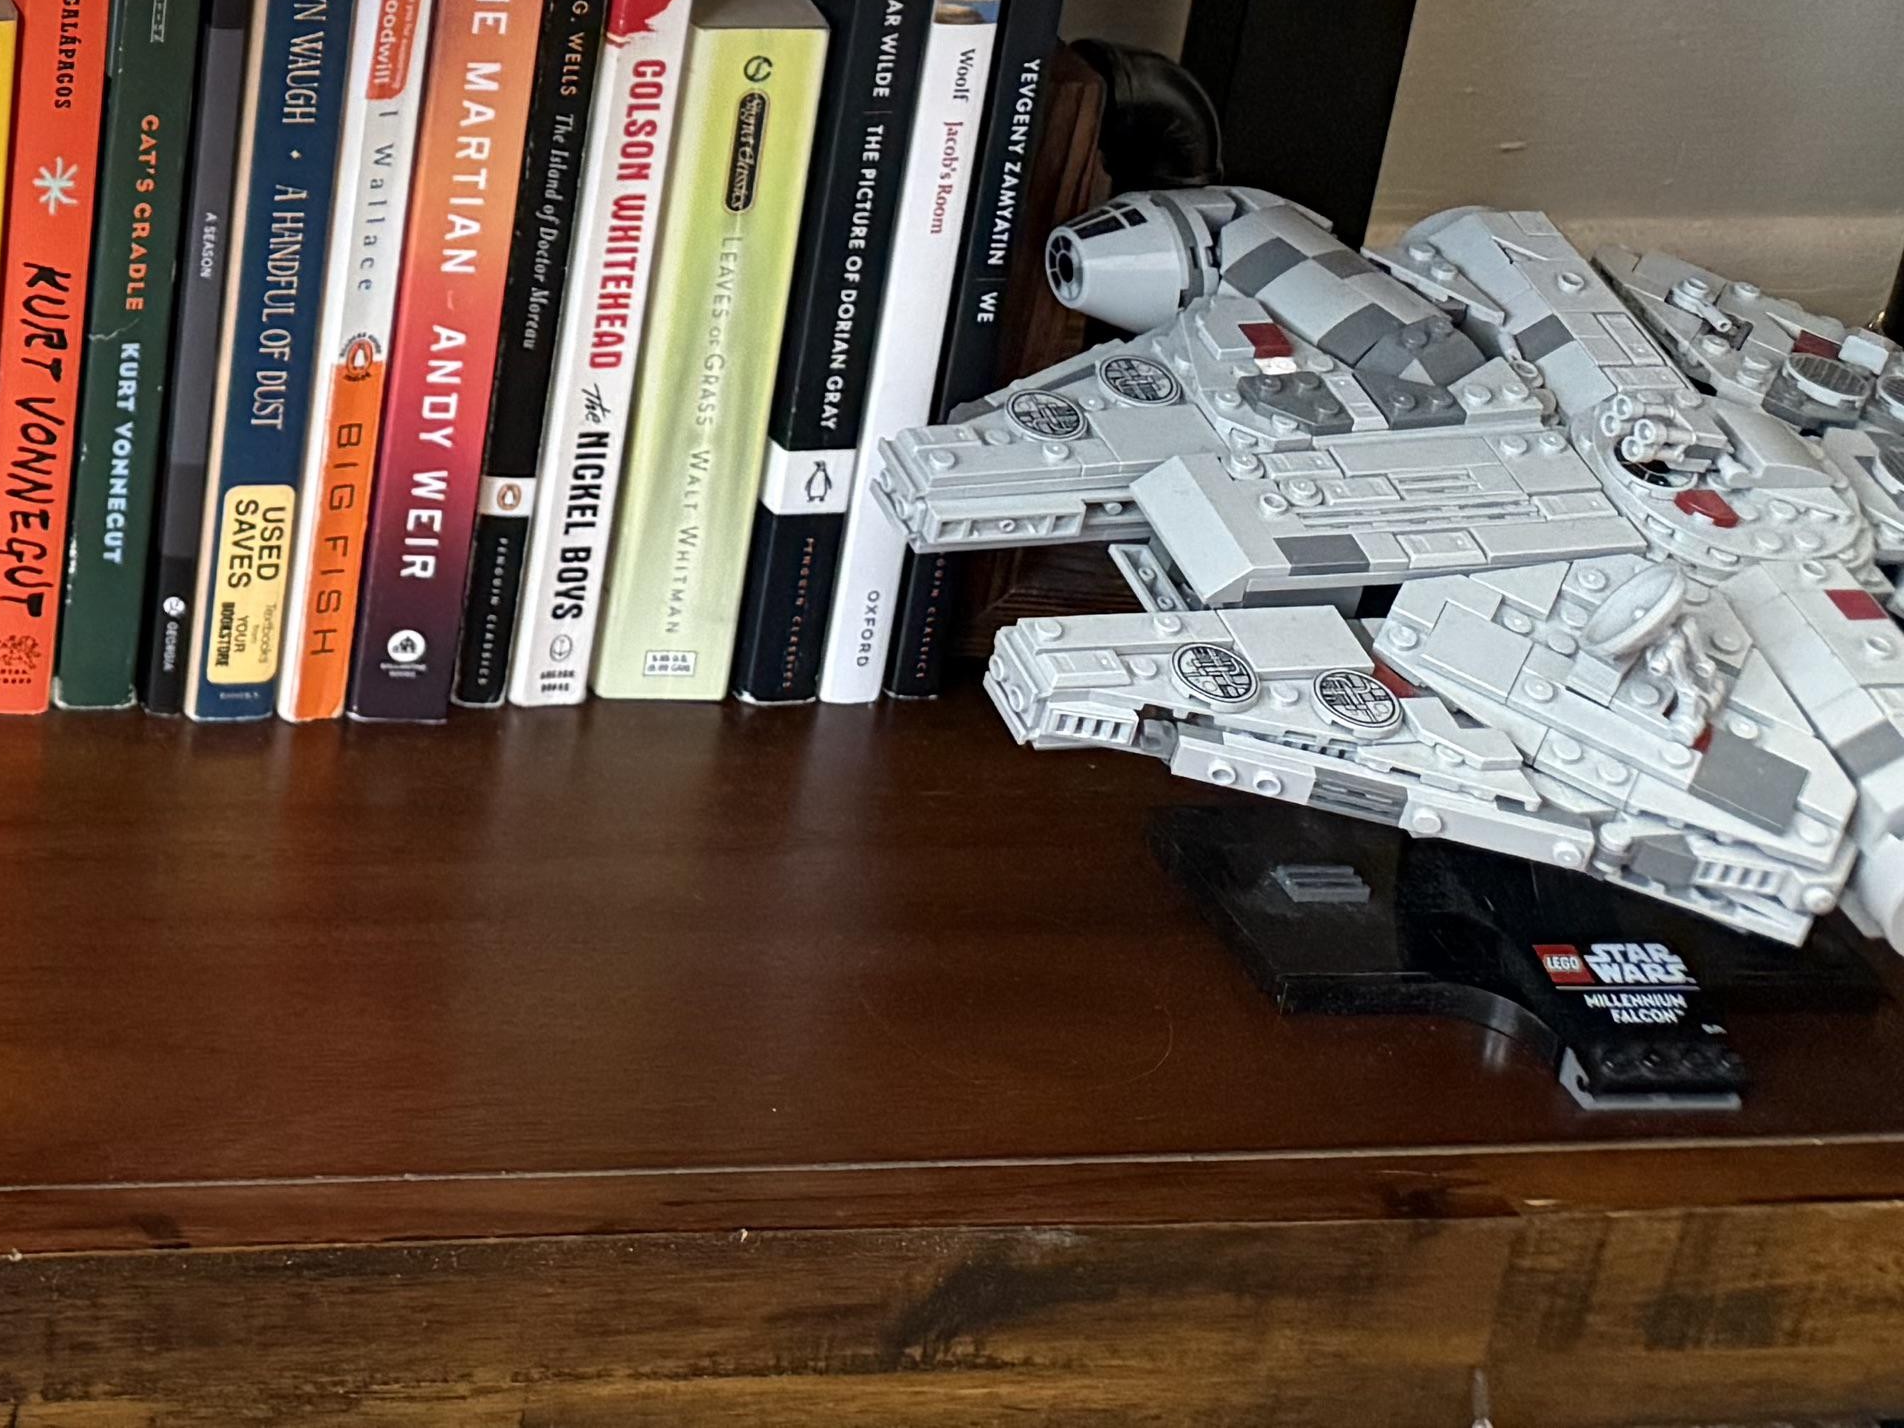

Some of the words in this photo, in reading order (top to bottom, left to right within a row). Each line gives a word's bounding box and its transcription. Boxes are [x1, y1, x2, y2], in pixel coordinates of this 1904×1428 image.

[281, 29, 324, 125] WAUGH
[614, 58, 667, 183] COLSON
[950, 48, 977, 103] Woolf
[440, 60, 501, 275] MARTIAN
[21, 262, 74, 383] KURT
[588, 194, 650, 370] WHITEHEAD
[413, 323, 468, 449] ANDY
[327, 422, 363, 512] BIG
[563, 430, 610, 535] NICKEL
[400, 472, 450, 582] WEIR
[313, 534, 348, 656] FISH
[551, 546, 592, 623] BOYS
[1544, 954, 1579, 973] LEGO
[1584, 944, 1682, 963] STAR
[1584, 994, 1686, 1009] MILLENNIUM
